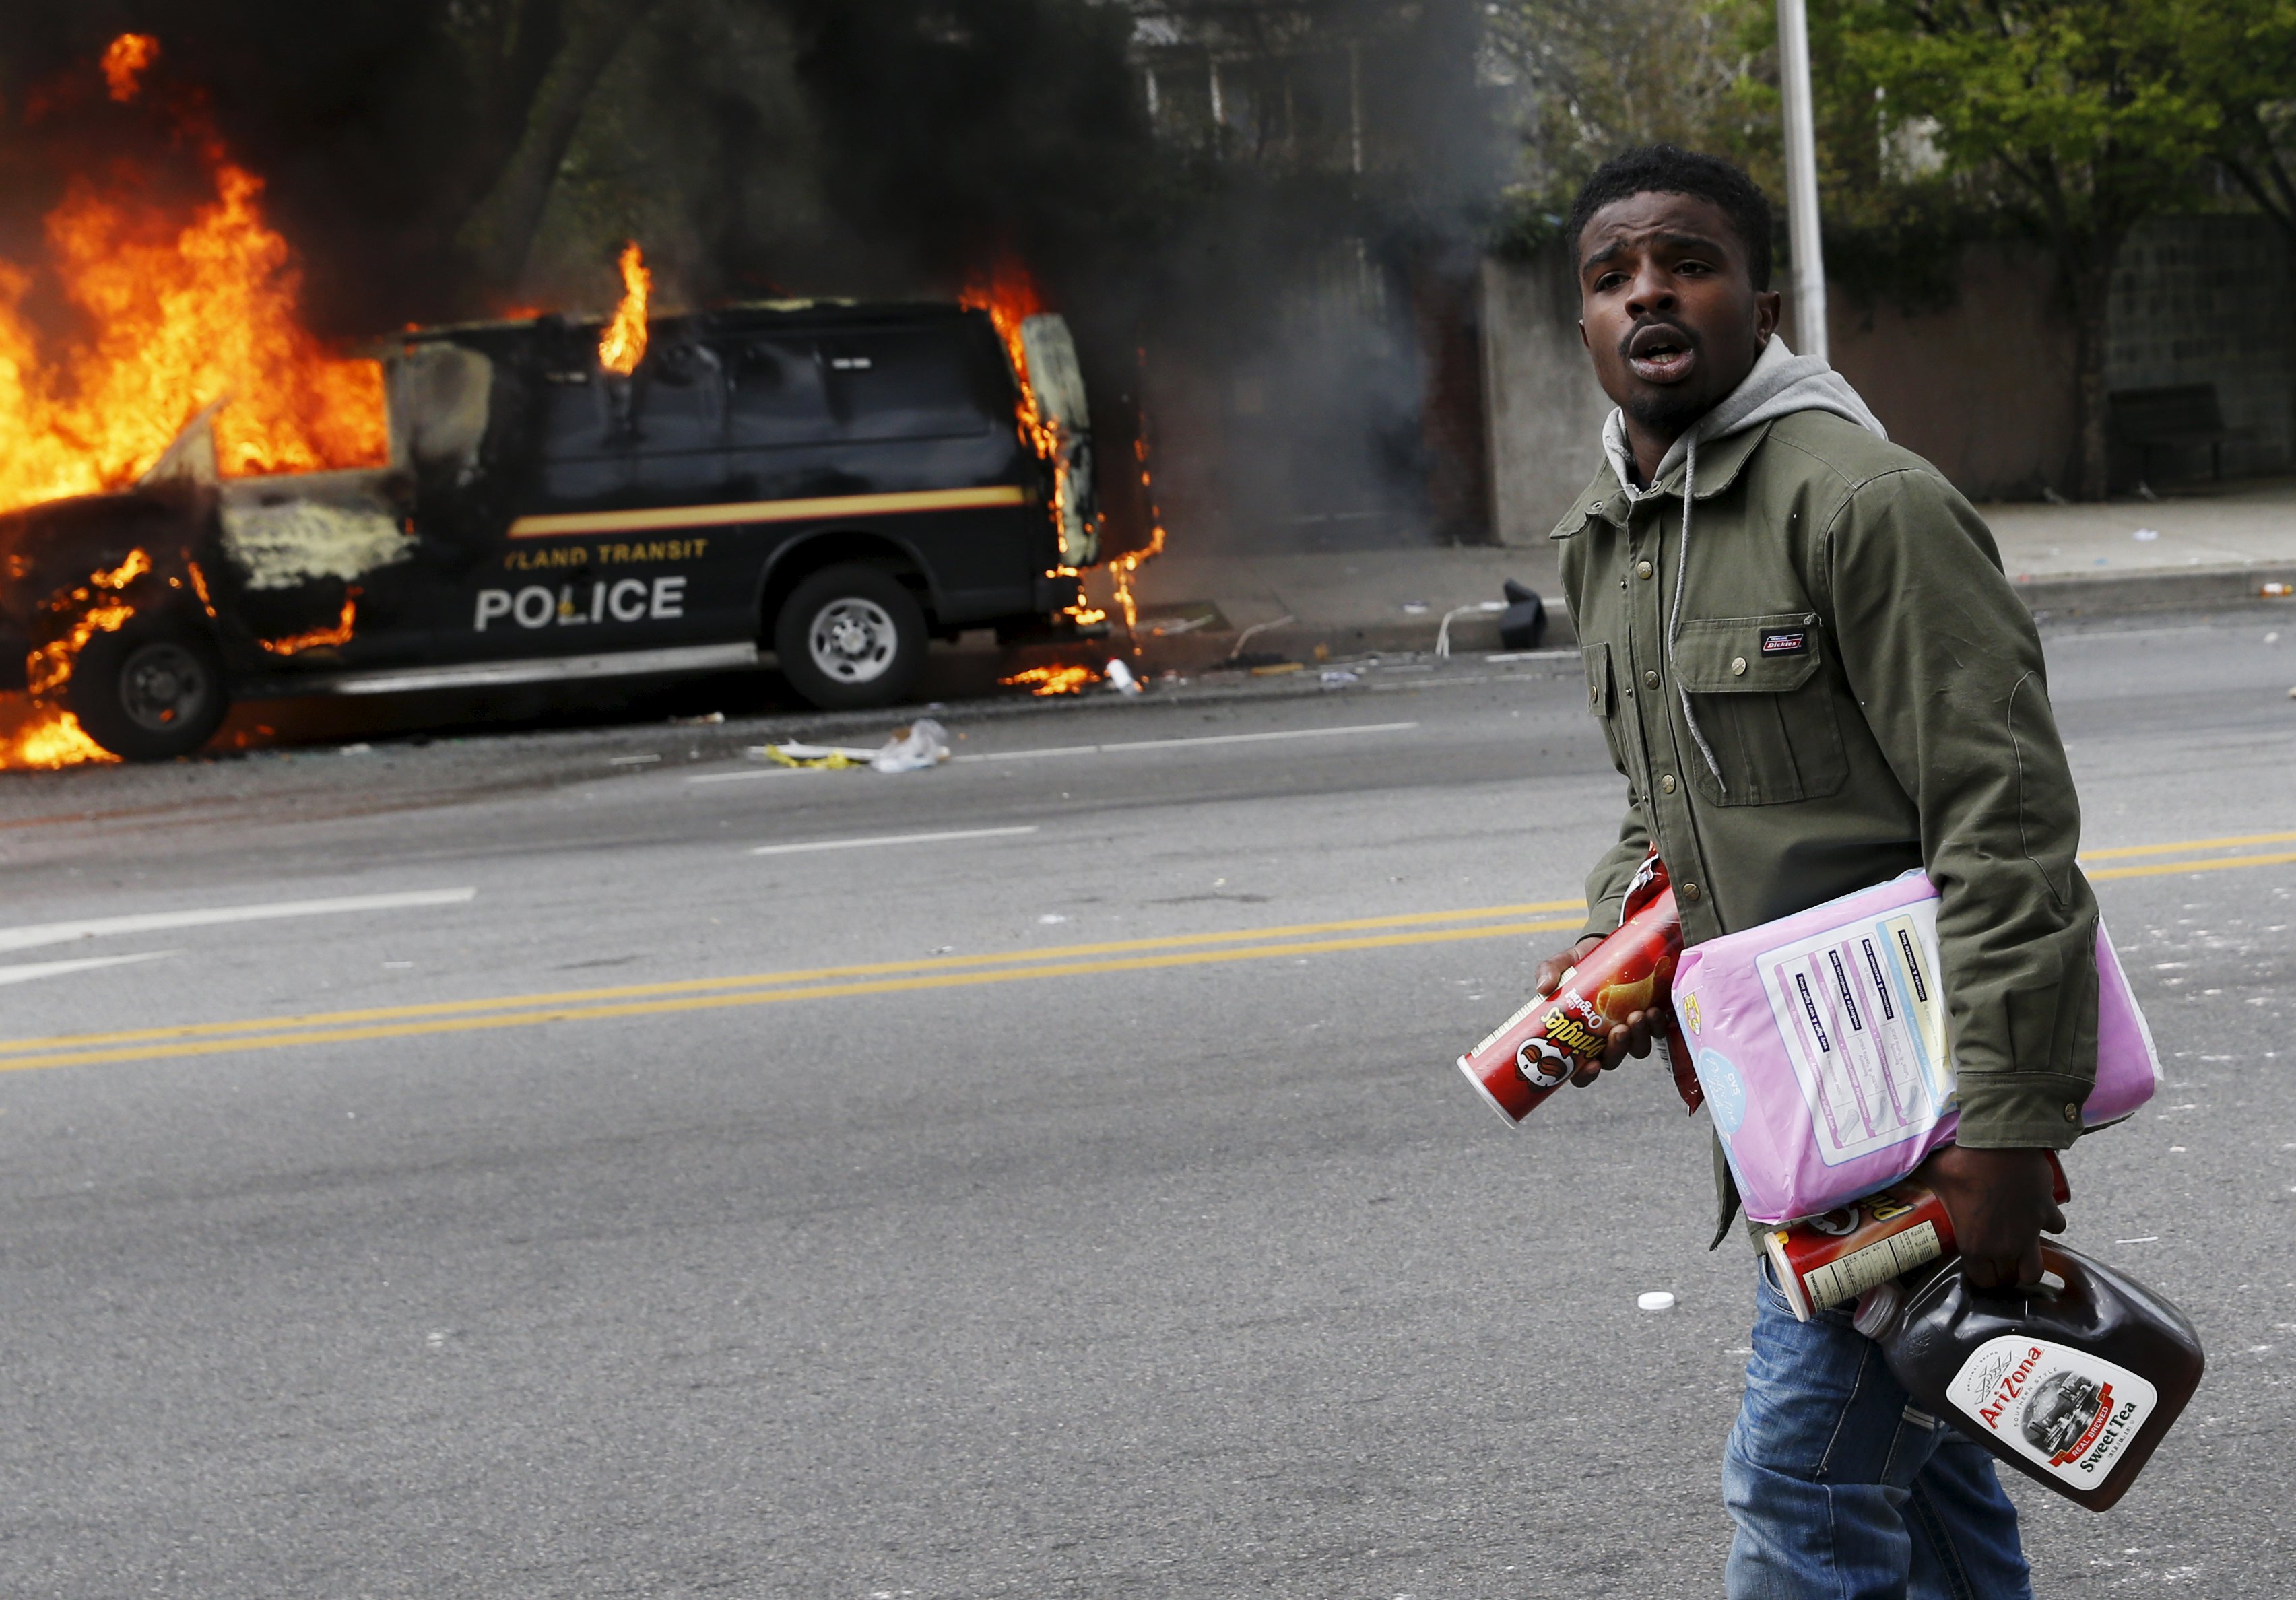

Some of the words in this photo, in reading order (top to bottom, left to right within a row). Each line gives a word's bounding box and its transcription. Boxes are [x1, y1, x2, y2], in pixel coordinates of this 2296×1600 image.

[597, 539, 709, 564] TRANSIT
[474, 576, 687, 633] POLICE
[1767, 640, 1797, 648] Dickies
[1863, 940, 1872, 954] long
[1899, 931, 1908, 945] long
[1830, 952, 1839, 966] long
[1868, 954, 1882, 983] maximum
[1903, 945, 1916, 970] ultimate
[1797, 975, 1806, 990] long
[1834, 965, 1848, 995] moderate
[1913, 975, 1926, 1000] ultimate
[1565, 987, 1603, 1029] Original
[1802, 989, 1811, 1004] light
[1879, 988, 1893, 1017] maximum
[1806, 1003, 1816, 1018] very
[1846, 999, 1860, 1028] moderate
[1540, 1007, 1606, 1058] Pringles
[1814, 1022, 1824, 1037] light
[1819, 1035, 1829, 1050] very
[1907, 1015, 1926, 1058] absorbency
[1841, 1048, 1858, 1087] absorbency
[1726, 1071, 1742, 1096] CVS
[1821, 1099, 1831, 1115] light
[1854, 1086, 1868, 1119] moderate
[1979, 1346, 2043, 1429] AriZona
[2014, 1385, 2033, 1426] SOUTHERN
[2033, 1366, 2057, 1384] STYLE
[2071, 1438, 2091, 1457] REAL
[2087, 1405, 2109, 1438] BREWED
[2078, 1426, 2118, 1473] Sweet
[2108, 1401, 2136, 1428] Tea
